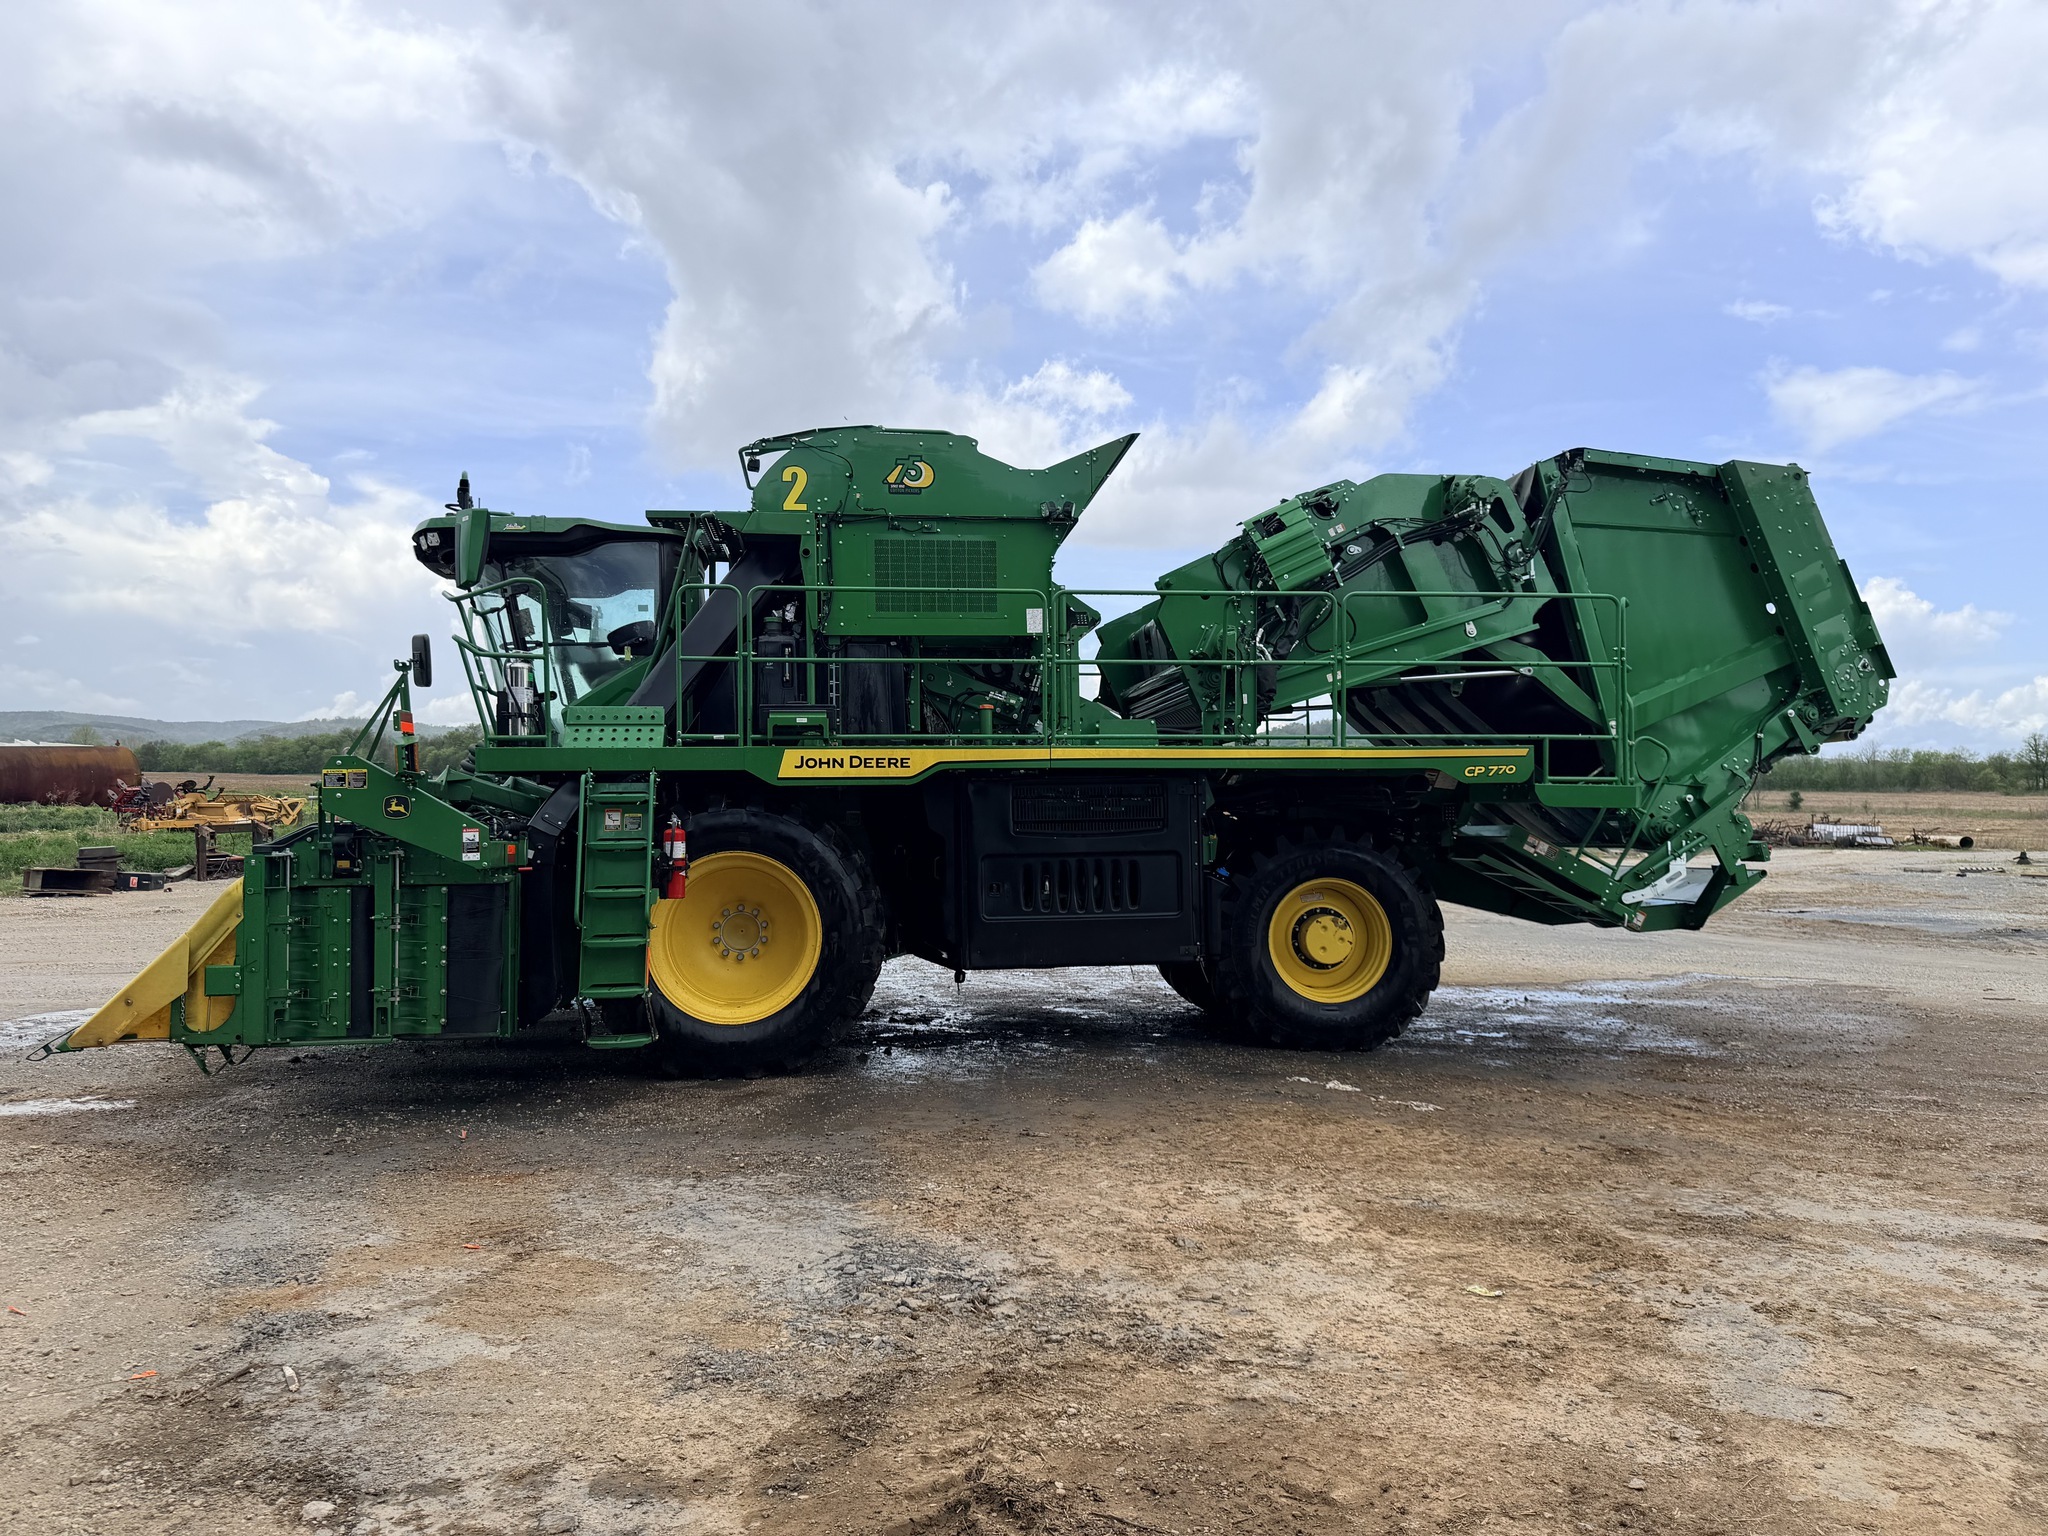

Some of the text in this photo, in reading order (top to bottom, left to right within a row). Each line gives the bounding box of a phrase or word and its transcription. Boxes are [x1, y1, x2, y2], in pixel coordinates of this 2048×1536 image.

[782, 465, 808, 511] 2
[794, 756, 911, 769] JOHN DEERE
[1464, 765, 1516, 777] CP 770
